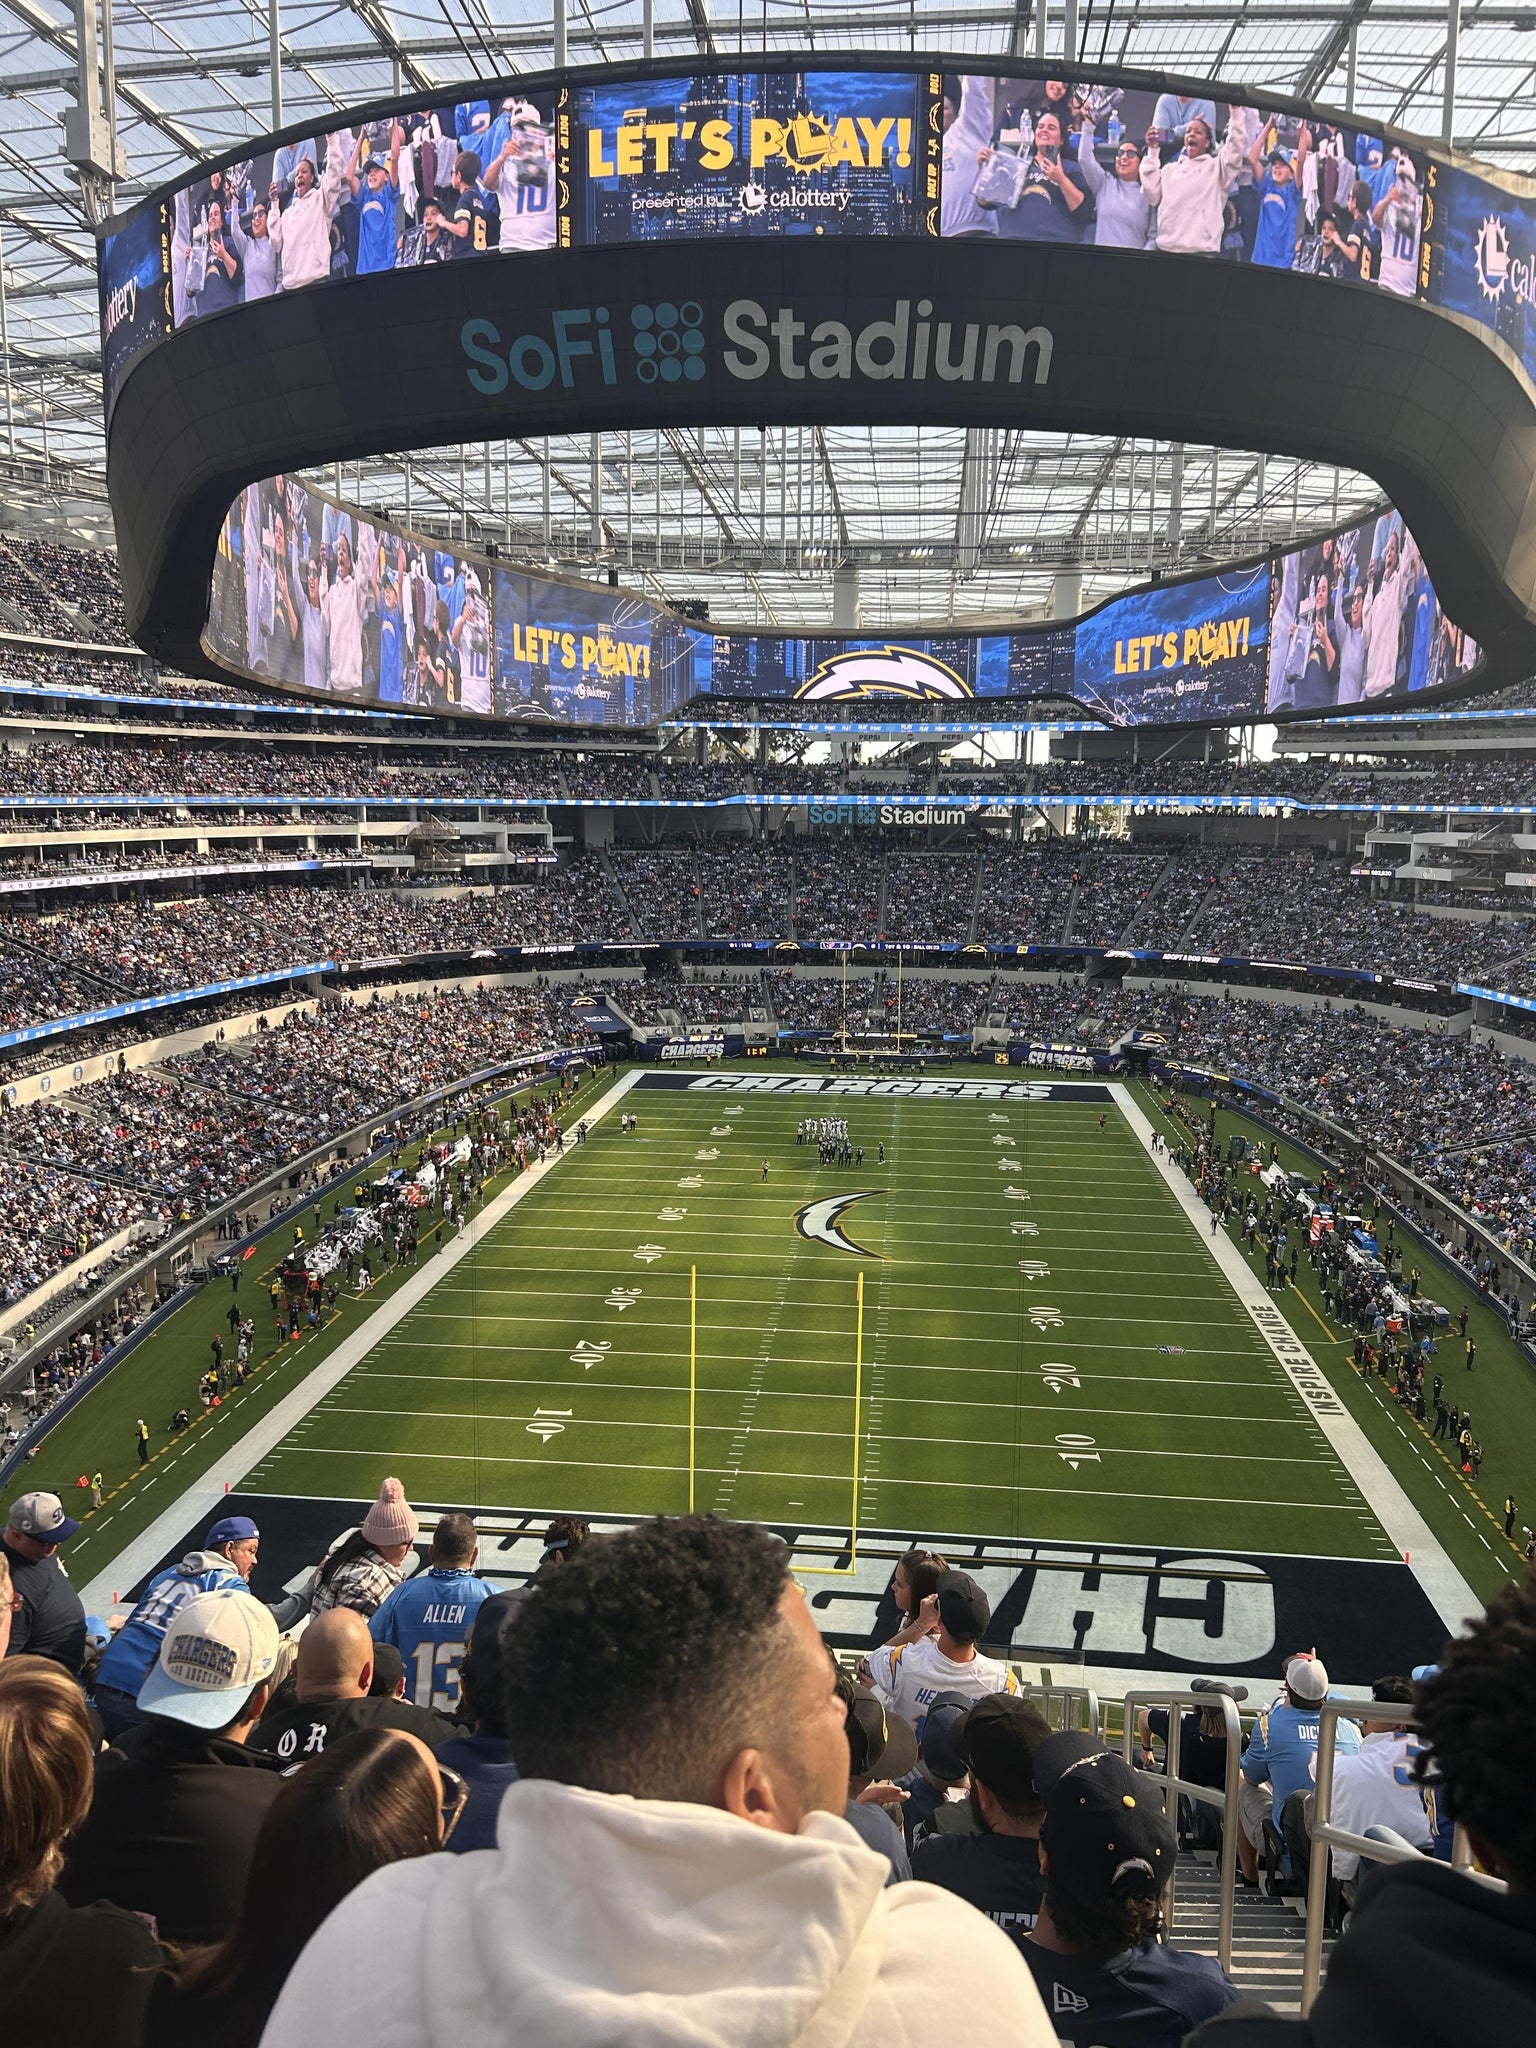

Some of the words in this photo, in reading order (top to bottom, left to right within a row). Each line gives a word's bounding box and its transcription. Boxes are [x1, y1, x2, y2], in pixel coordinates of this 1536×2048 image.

[560, 115, 569, 136] BOLT
[560, 137, 569, 149] UP
[588, 119, 734, 178] LET'S
[751, 111, 911, 176] PLAY!
[927, 163, 937, 180] UP
[516, 185, 548, 214] 10
[632, 195, 703, 211] presented
[706, 195, 725, 209] by
[770, 186, 850, 210] calottery
[927, 181, 937, 199] BOLT
[561, 216, 571, 236] BOLT
[162, 233, 168, 248] UP
[1422, 242, 1431, 270] BOLT
[1421, 271, 1429, 288] UP
[460, 306, 617, 395] SoFi
[723, 300, 1054, 385] Stadium
[513, 623, 576, 669] LET'S
[582, 635, 650, 679] PLAY!
[1114, 632, 1178, 674] LET'S
[1183, 617, 1250, 668] PLAY!
[809, 805, 853, 824] SoFi
[880, 805, 965, 825] Stadium
[1202, 956, 1221, 964] TODAY
[661, 1043, 724, 1057] CHARGERS
[687, 1076, 1052, 1100] CHARGERS
[657, 1207, 688, 1220] 50
[1010, 1221, 1040, 1236] 50
[633, 1243, 666, 1260] 40
[1018, 1260, 1051, 1278] 40
[604, 1287, 642, 1307] 30
[1028, 1306, 1064, 1328] 30
[1250, 1304, 1303, 1353] CHANGE
[569, 1340, 612, 1364] 20
[1040, 1362, 1081, 1389] 20
[1283, 1358, 1344, 1416] INSPIRE
[525, 1407, 573, 1437] 10
[1055, 1433, 1101, 1464] 10
[423, 1604, 466, 1624] ALLEN
[168, 1634, 238, 1680] CHARGERS
[411, 1642, 467, 1714] 13
